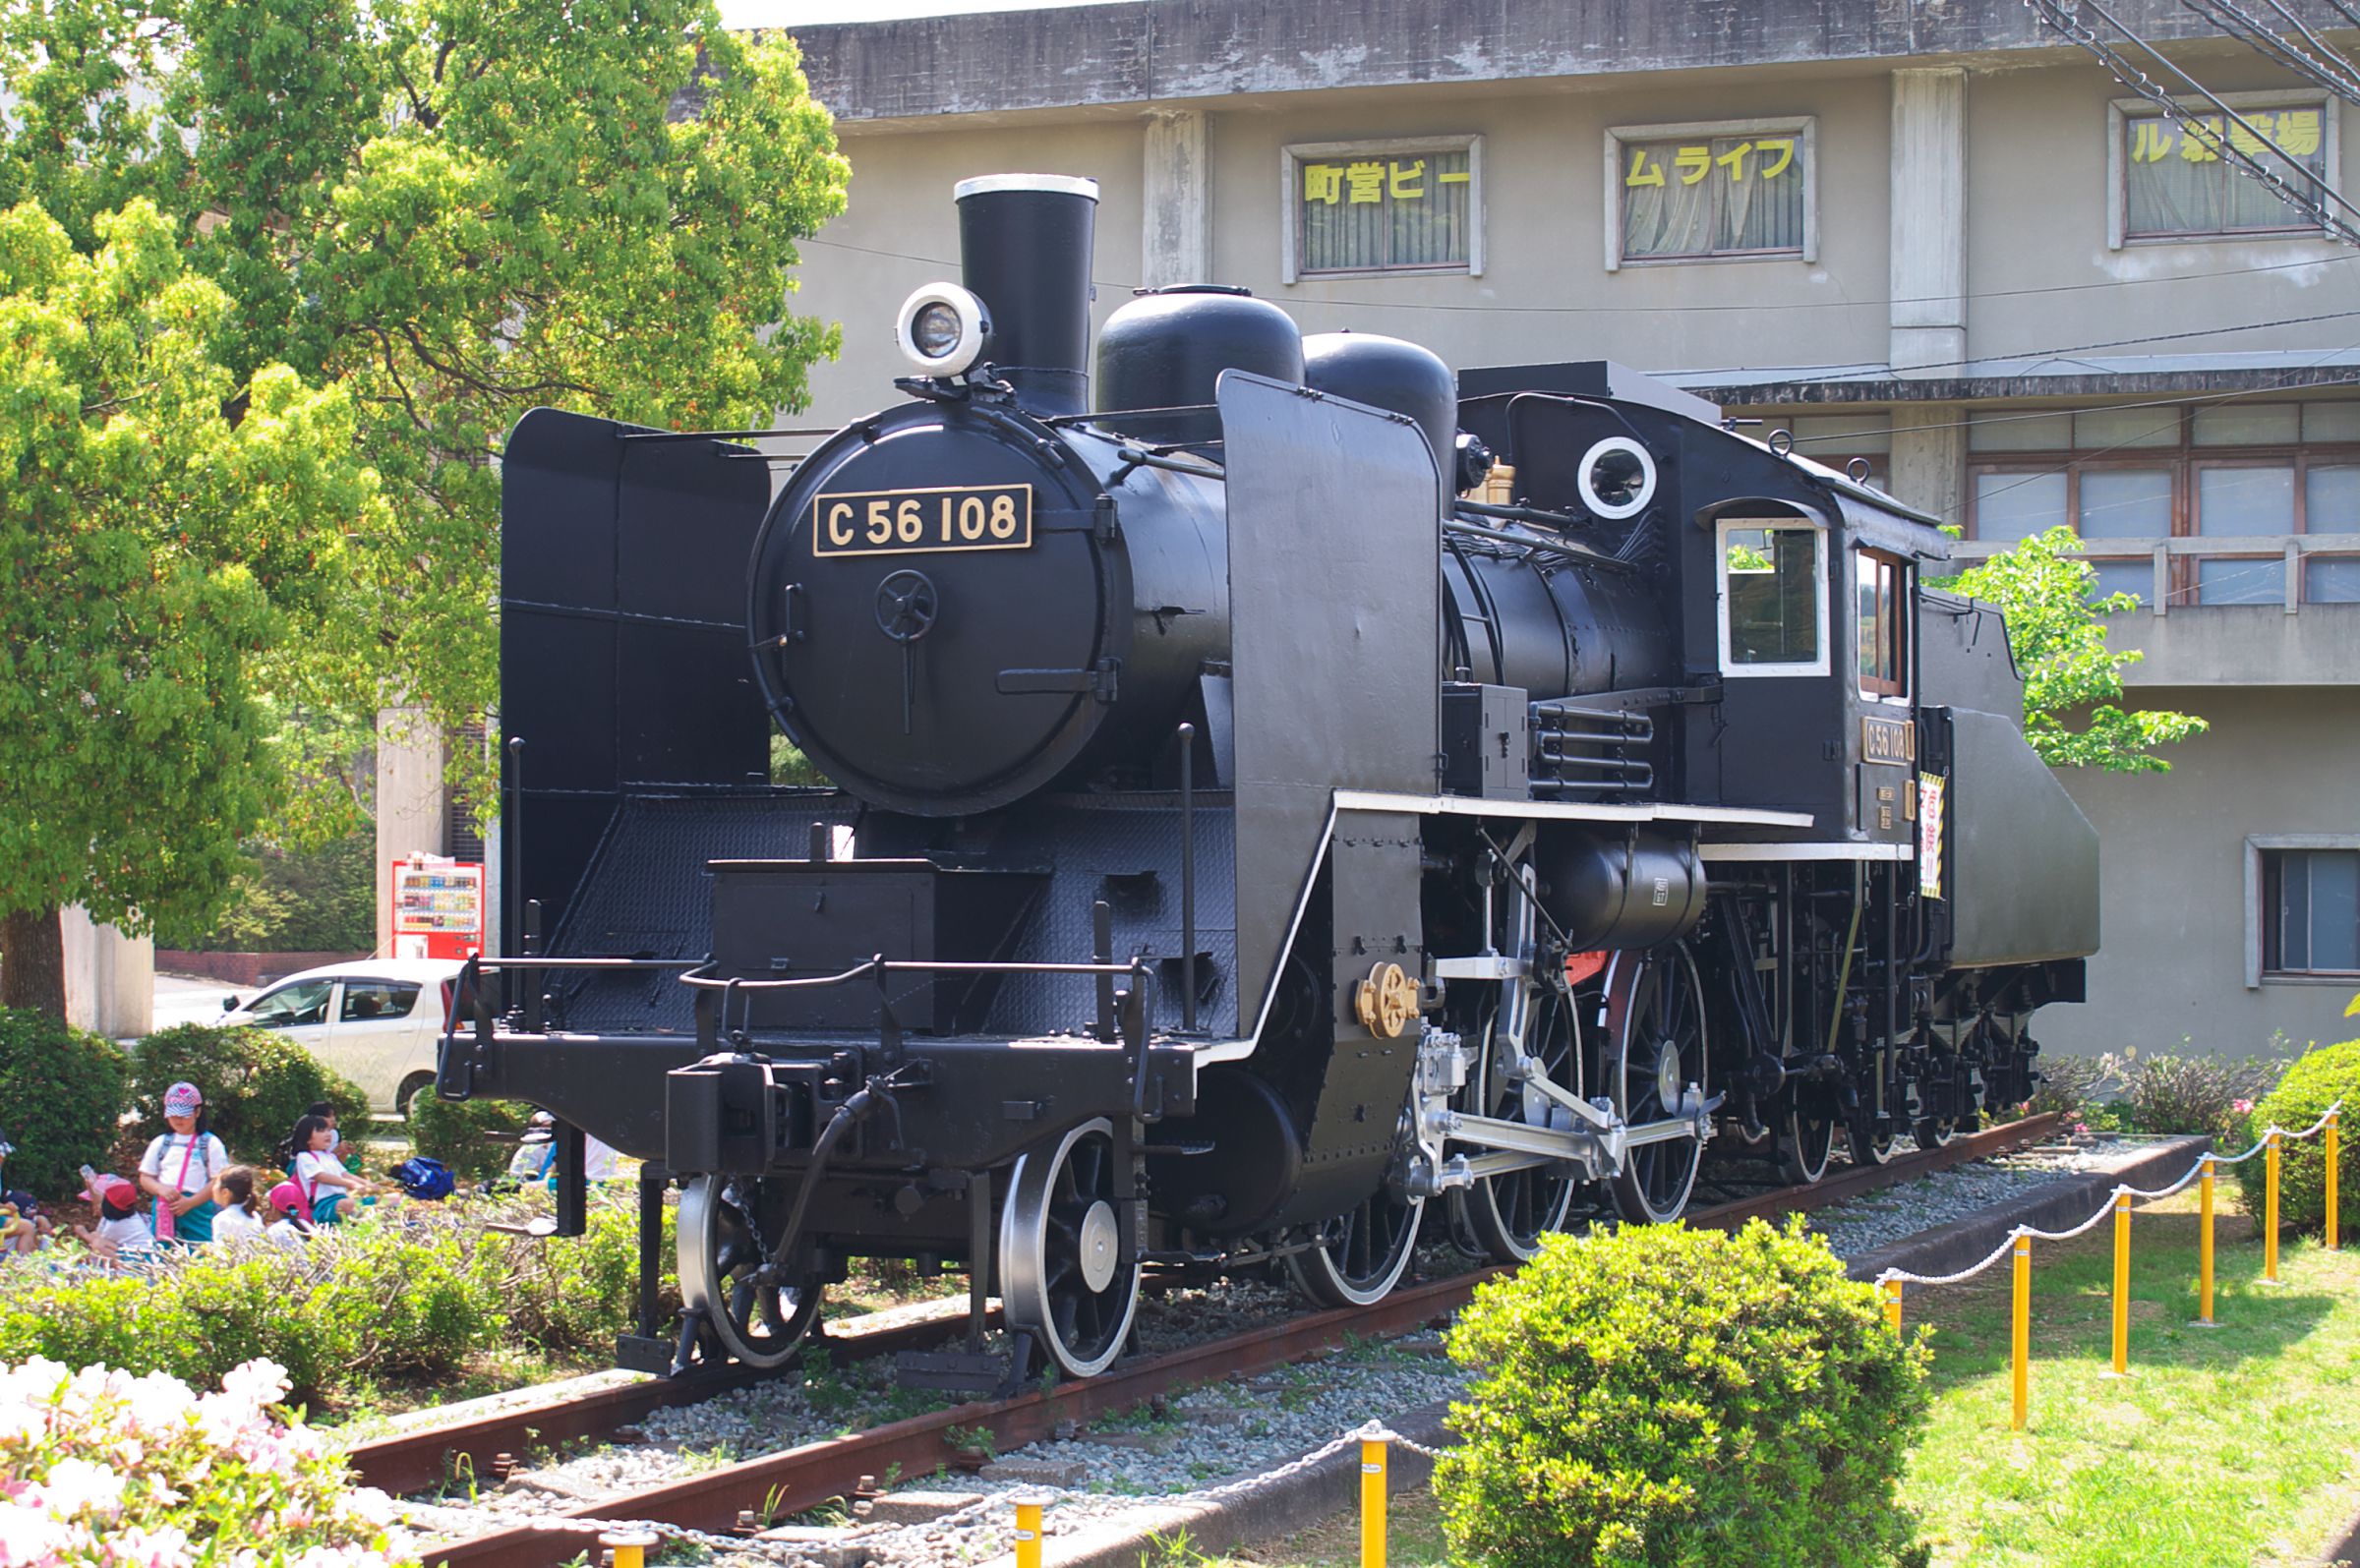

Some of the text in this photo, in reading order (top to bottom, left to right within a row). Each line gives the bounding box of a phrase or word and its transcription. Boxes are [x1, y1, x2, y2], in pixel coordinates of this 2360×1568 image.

[1304, 159, 1471, 204] 町営ビー
[1625, 139, 1795, 188] ムライフ
[941, 494, 1017, 542] 108
